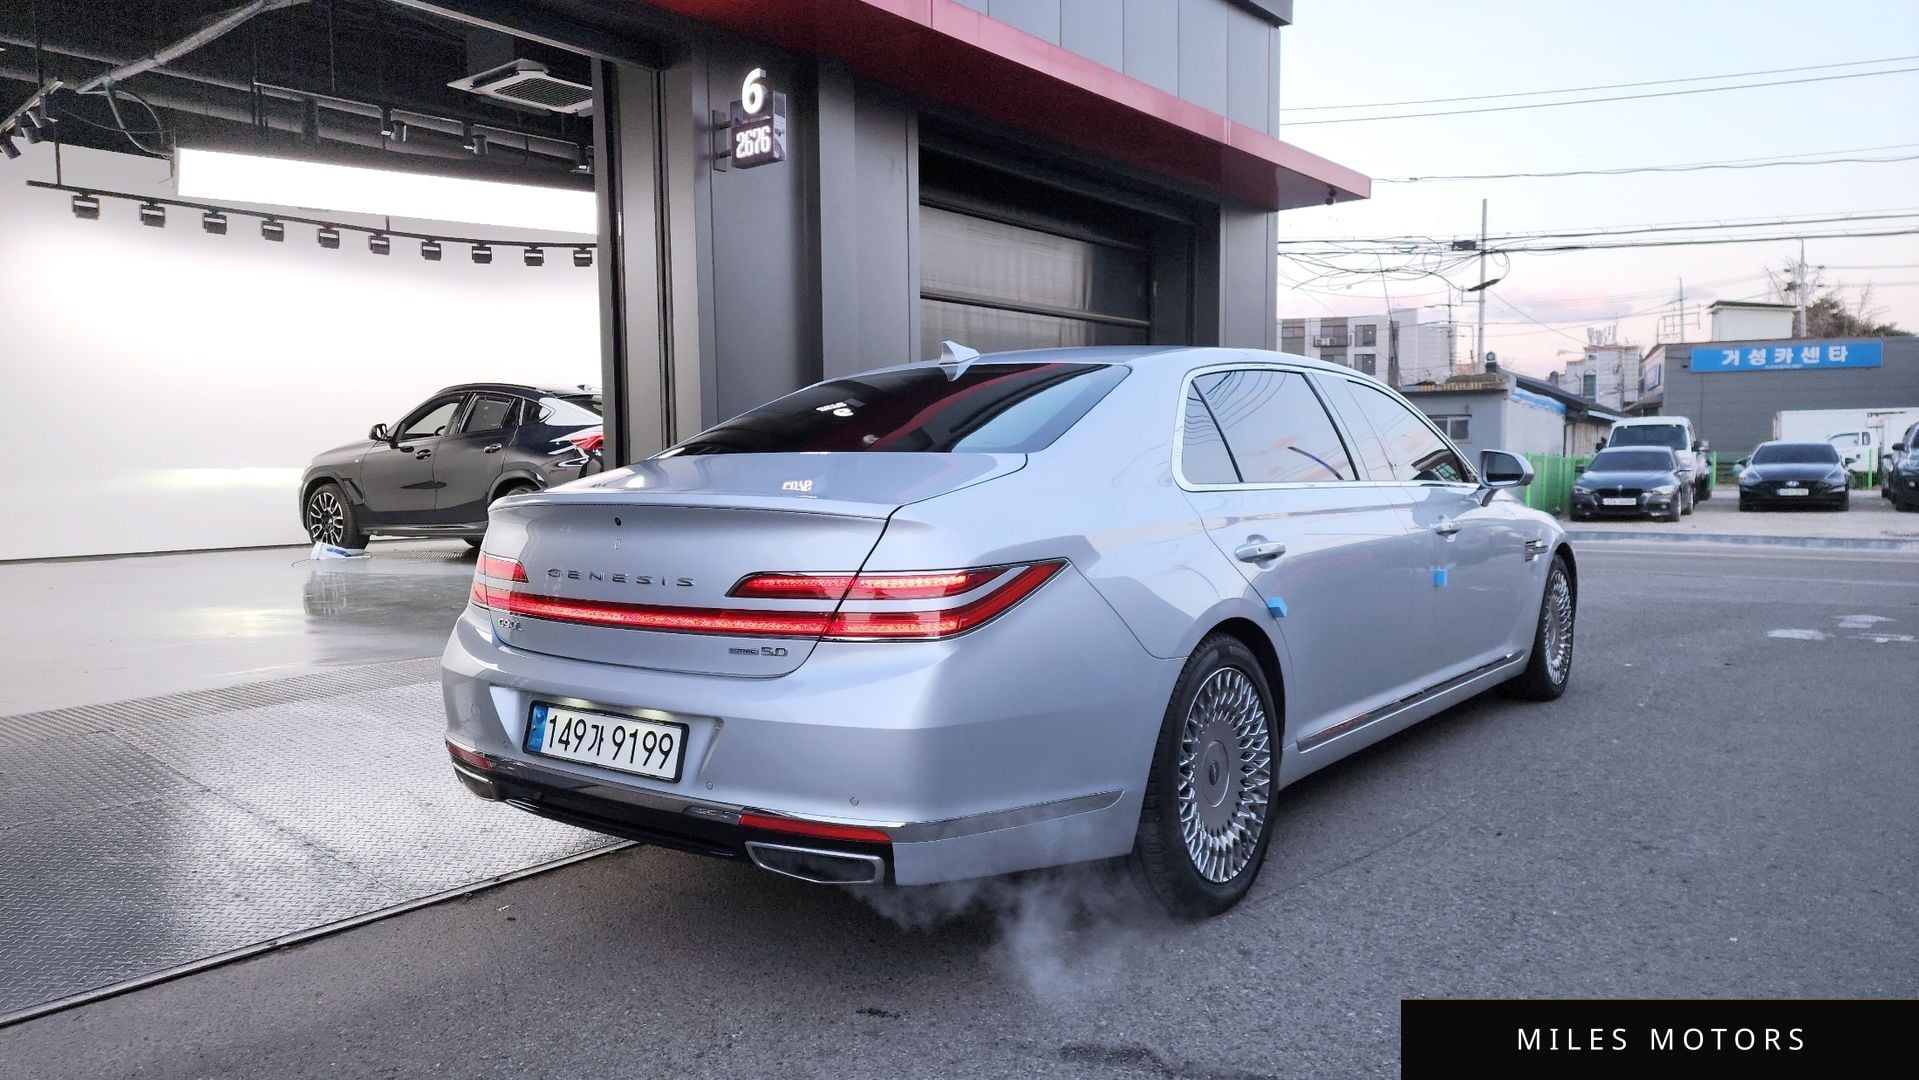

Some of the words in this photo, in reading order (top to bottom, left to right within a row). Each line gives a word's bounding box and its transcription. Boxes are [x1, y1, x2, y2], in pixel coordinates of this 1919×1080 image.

[742, 68, 767, 114] 6
[736, 125, 772, 159] 2676
[547, 568, 695, 587] GENESIS
[612, 725, 674, 769] 9199
